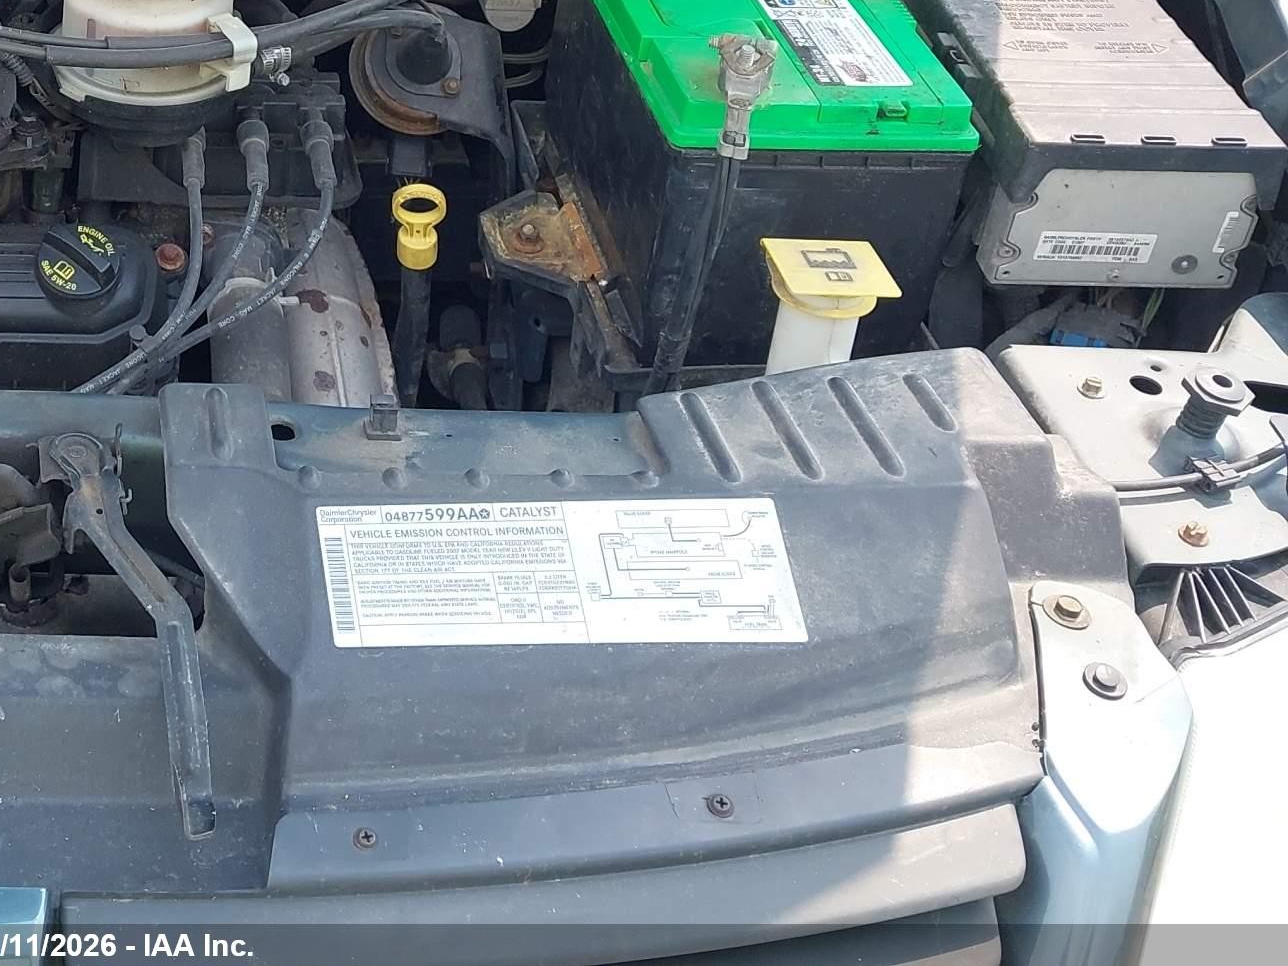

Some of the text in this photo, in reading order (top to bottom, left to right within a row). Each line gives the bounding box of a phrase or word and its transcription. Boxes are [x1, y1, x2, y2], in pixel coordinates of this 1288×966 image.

[78, 225, 116, 257] ENGINE OIL
[41, 260, 77, 291] SAE 5W-20
[217, 315, 235, 329] CORE
[319, 509, 377, 517] DaimlerChrysler
[498, 506, 558, 517] CATALYST
[349, 526, 564, 538] VEHICLE EMISSION CONTROL INFORMATION
